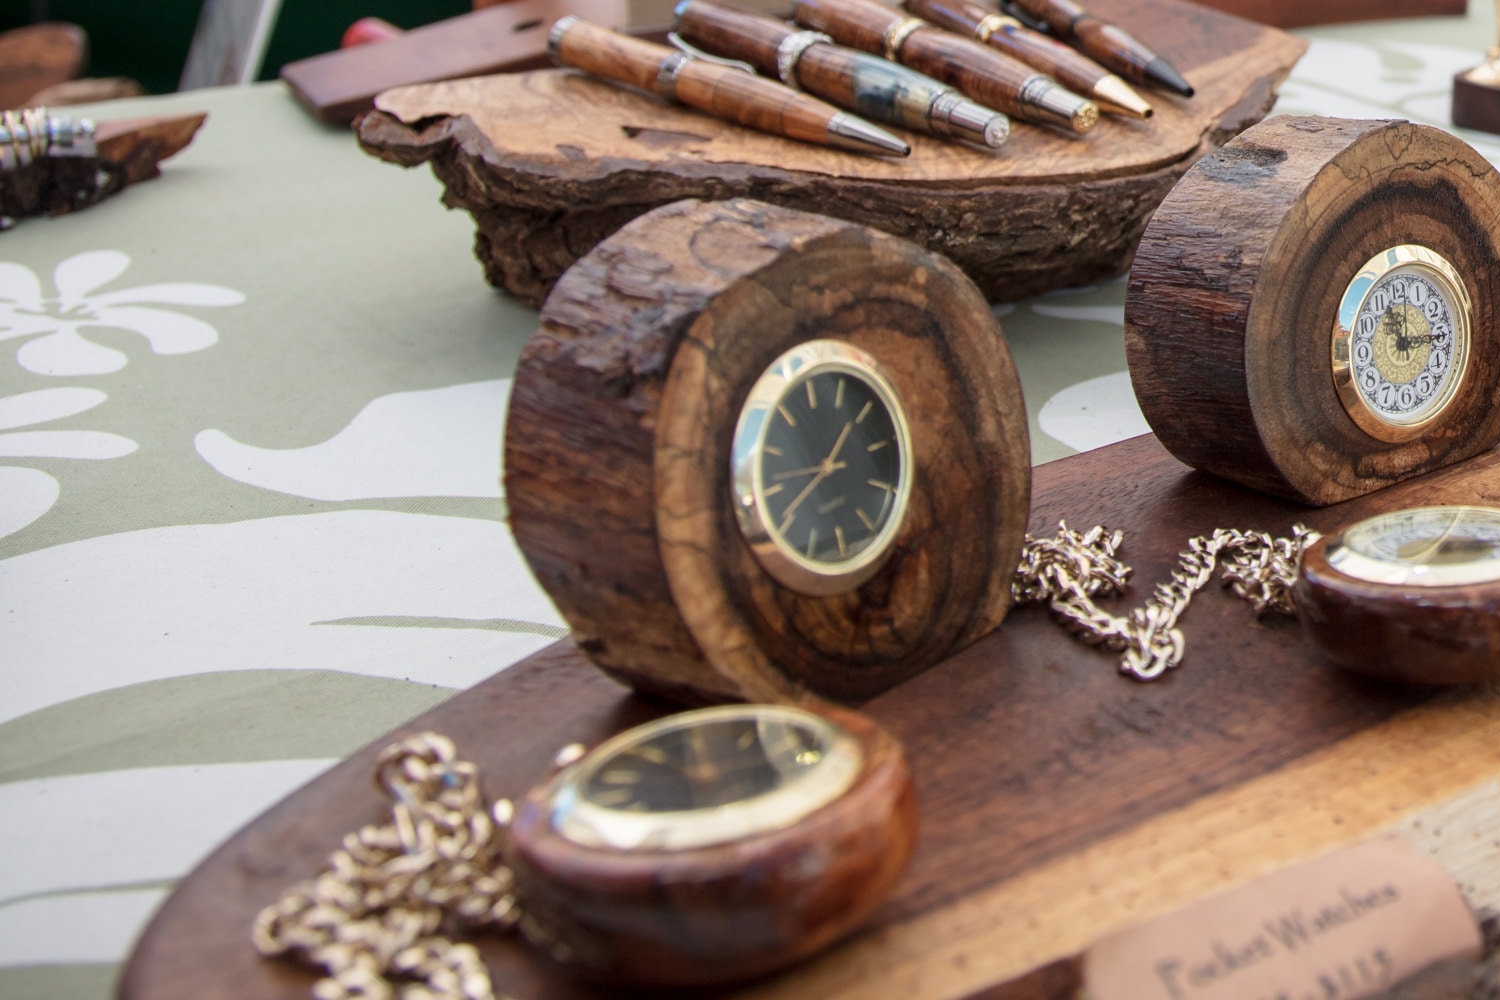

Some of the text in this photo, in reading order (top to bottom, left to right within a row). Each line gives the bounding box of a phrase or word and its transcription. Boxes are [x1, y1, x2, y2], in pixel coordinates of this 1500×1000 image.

[1390, 281, 1406, 299] 12
[1374, 293, 1385, 312] 11
[1428, 300, 1439, 319] 2
[1359, 316, 1375, 334] 10
[1357, 344, 1370, 364] 9
[1431, 353, 1442, 372] 4
[1365, 372, 1376, 391] 8
[1419, 375, 1431, 394] 5
[1382, 385, 1391, 405] 7
[1400, 388, 1412, 407] 6
